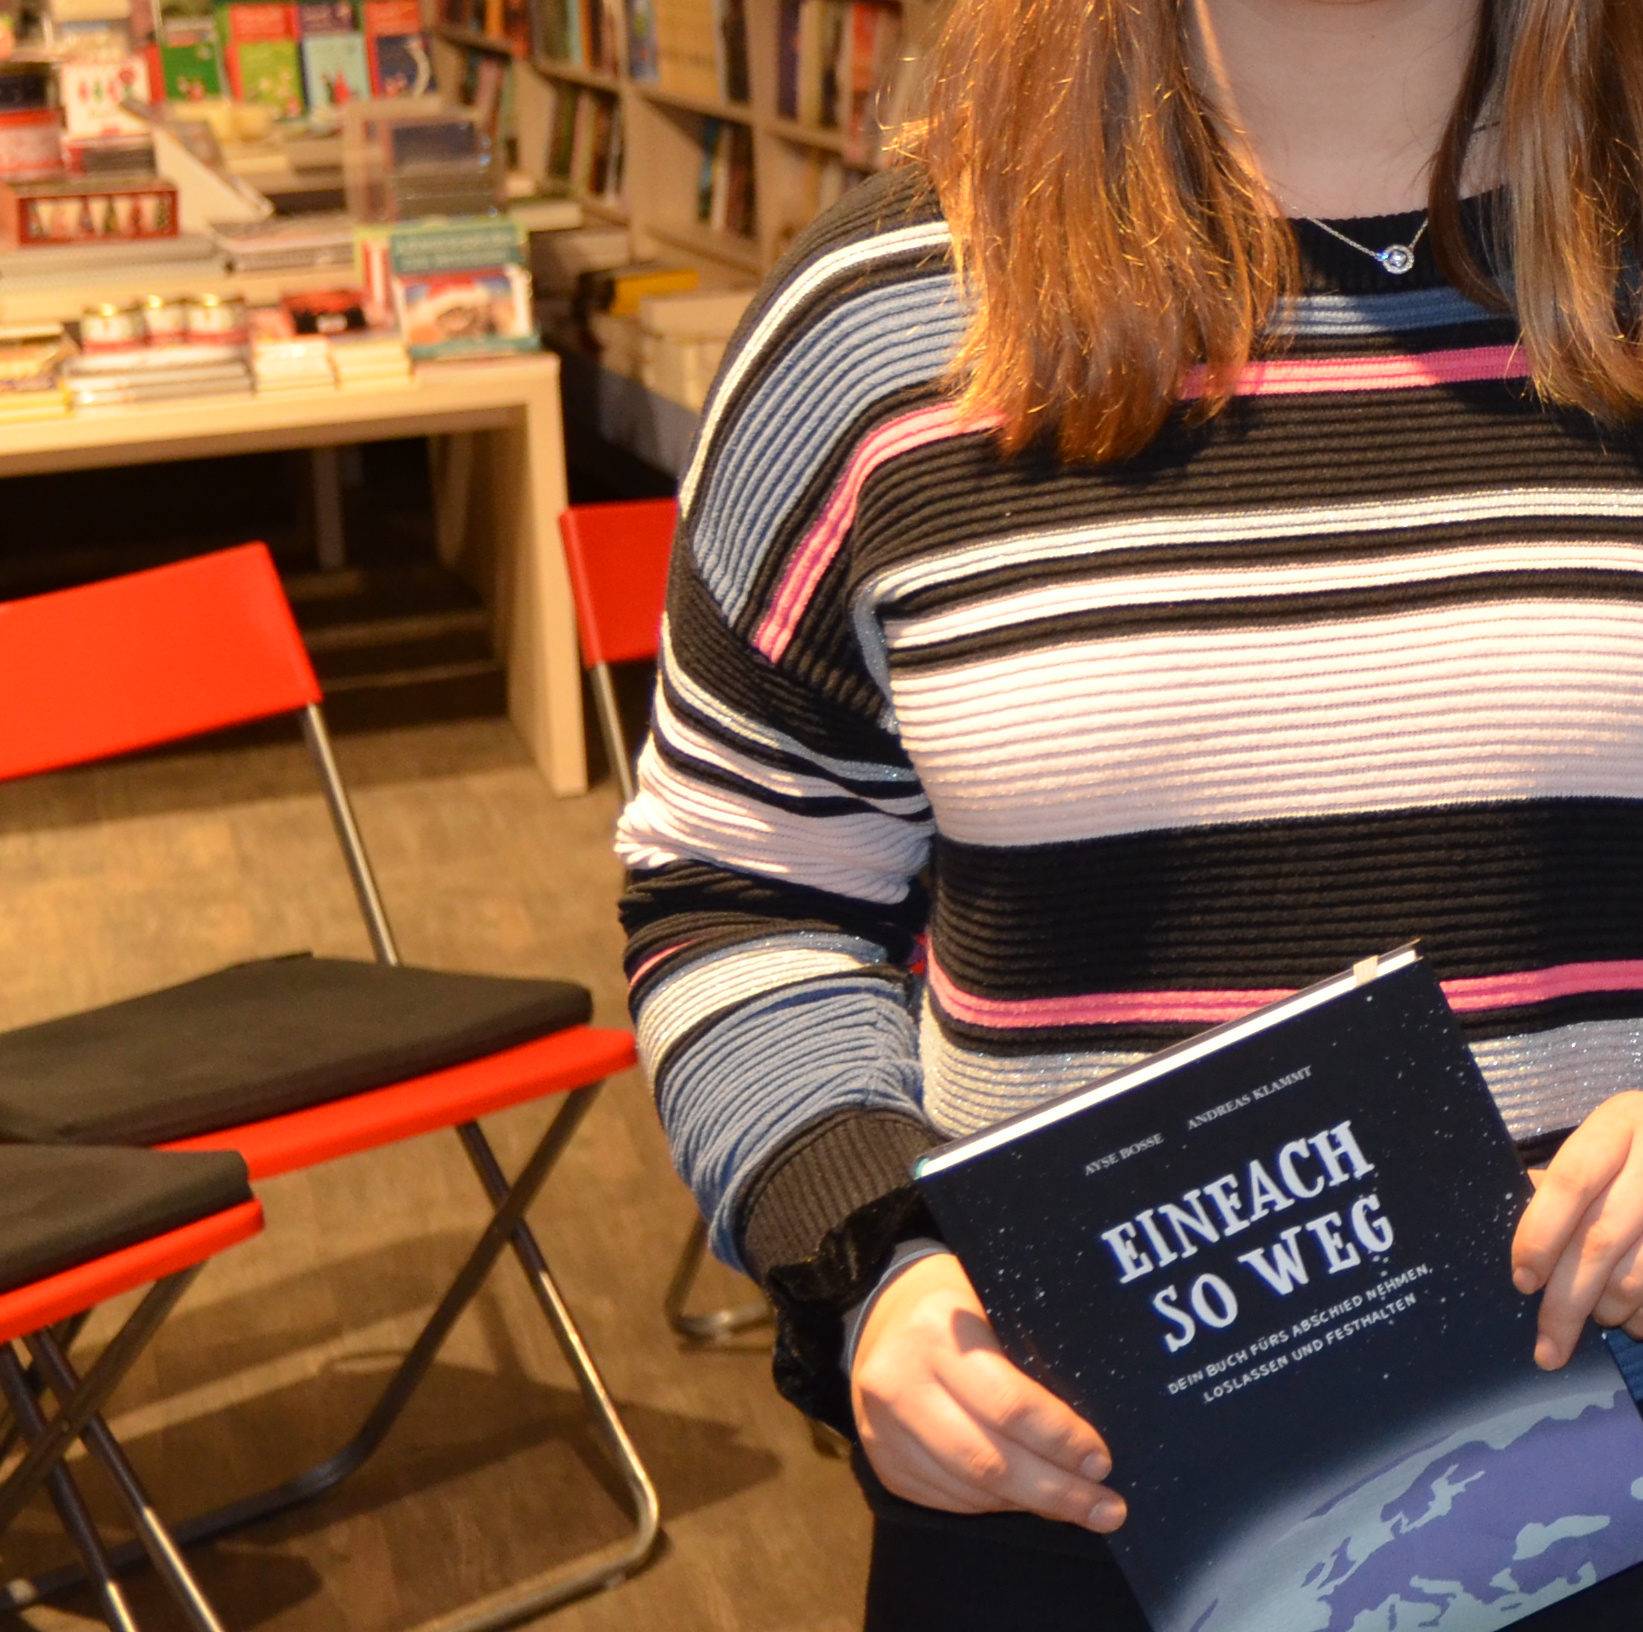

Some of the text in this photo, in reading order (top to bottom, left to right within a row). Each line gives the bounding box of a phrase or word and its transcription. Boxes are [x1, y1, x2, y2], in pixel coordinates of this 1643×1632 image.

[1119, 1132, 1165, 1160] BOSSE
[1187, 1094, 1251, 1130] ANDREAS
[1251, 1065, 1313, 1101] KLAMMT
[1100, 1119, 1376, 1286] EINFACH
[1152, 1193, 1396, 1353] SO WEG
[1167, 1264, 1434, 1396] DEIN BUCH FÜRS ABSCHIED NEHMEN,
[1202, 1292, 1417, 1404] LOSLASSEN UND FESTHALTEN
